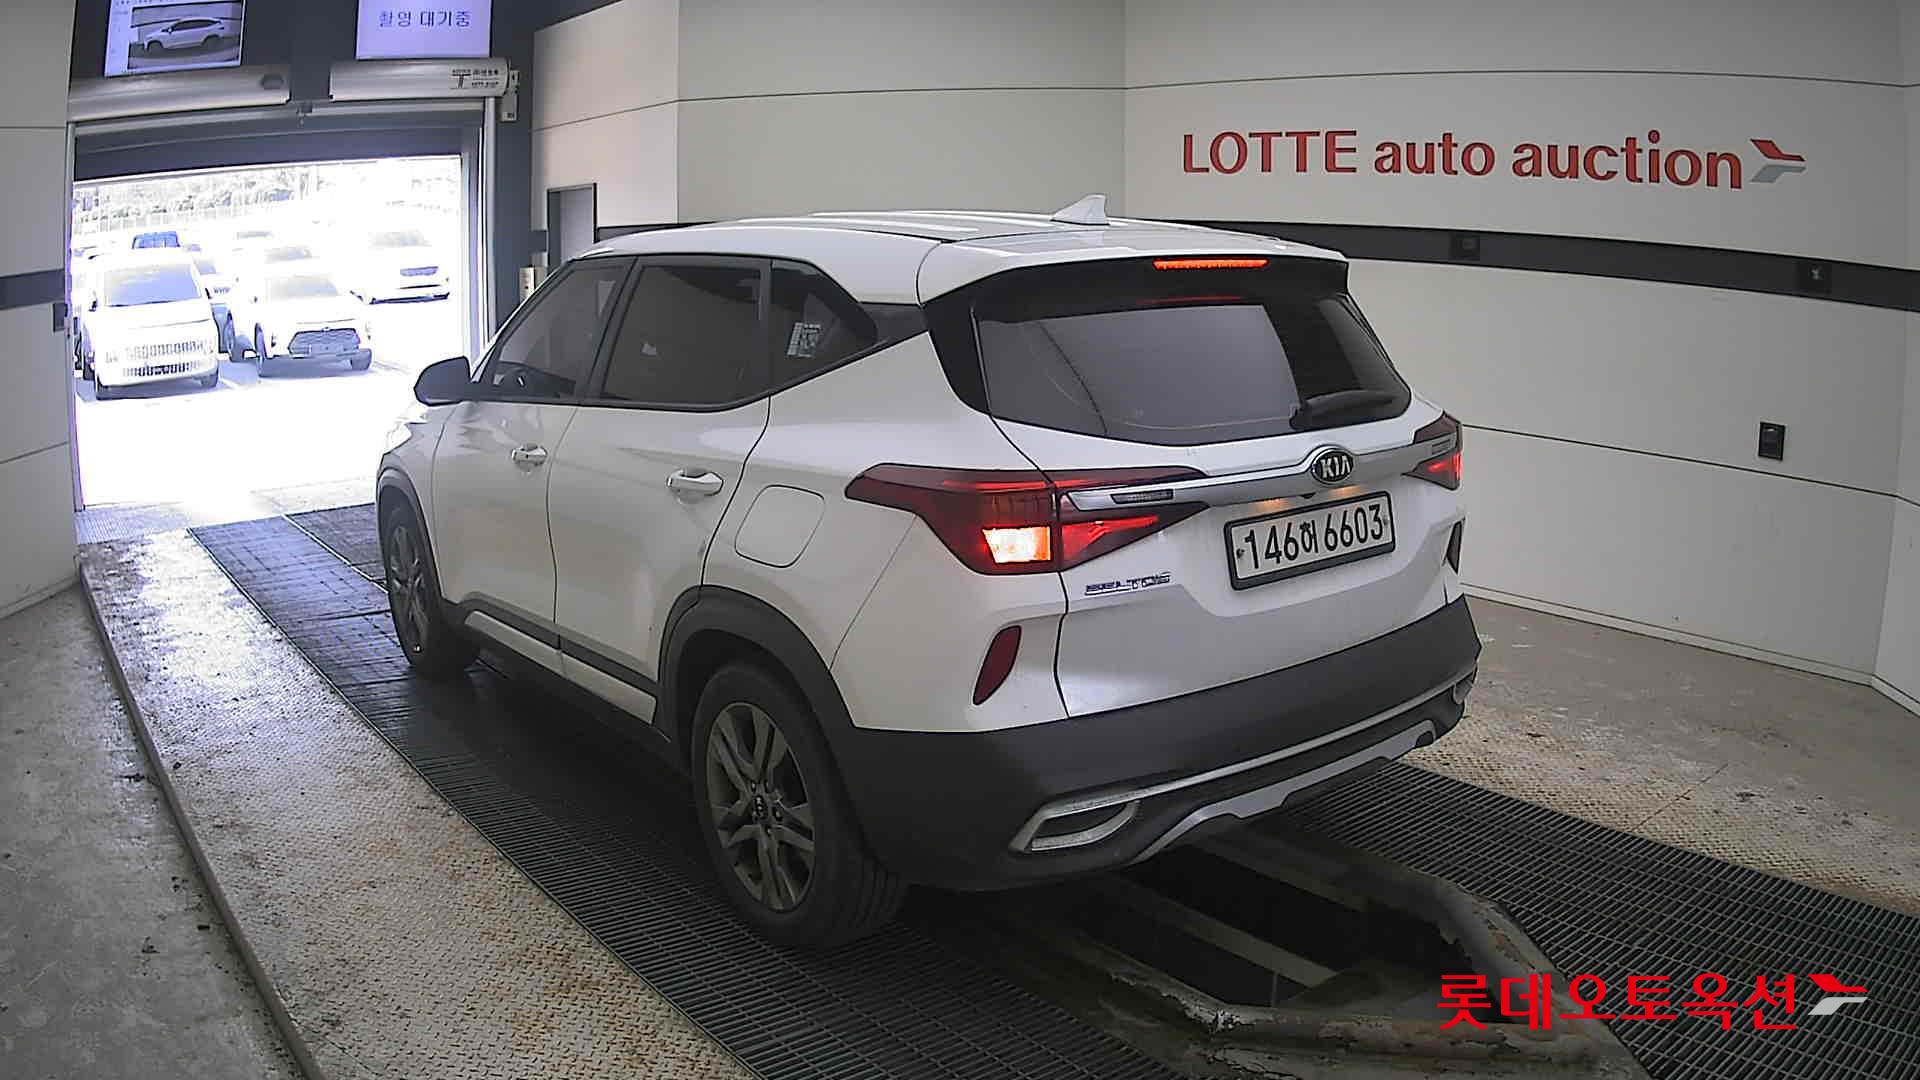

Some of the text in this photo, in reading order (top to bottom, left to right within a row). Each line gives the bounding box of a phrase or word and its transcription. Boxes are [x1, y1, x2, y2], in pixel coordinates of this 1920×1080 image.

[420, 11, 471, 28] 대기중
[1183, 130, 1743, 189] LOTTE auto auction
[1320, 455, 1351, 479] KIA
